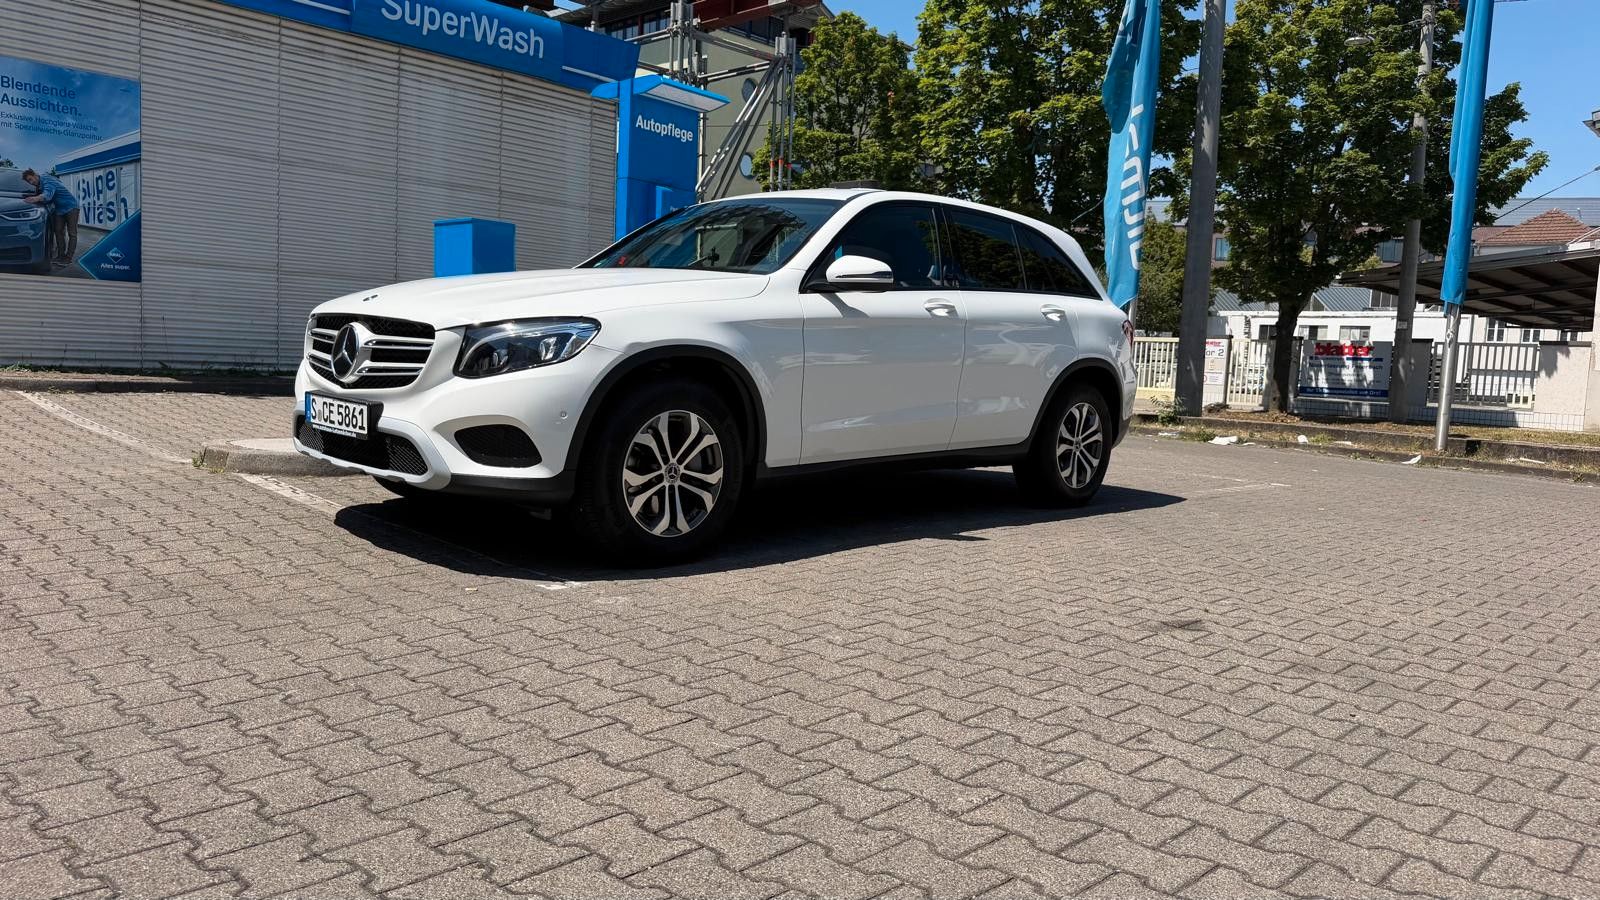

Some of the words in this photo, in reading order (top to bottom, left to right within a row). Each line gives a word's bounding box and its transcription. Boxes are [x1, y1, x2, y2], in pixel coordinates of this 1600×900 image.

[380, 0, 545, 59] SuperWash
[0, 75, 76, 99] Blendende
[0, 93, 82, 117] Aussichten.
[0, 121, 12, 129] mit
[635, 114, 694, 142] Autopflege
[1217, 348, 1225, 357] 2
[311, 398, 317, 420] S
[322, 401, 336, 425] CE
[337, 403, 366, 431] 5861
